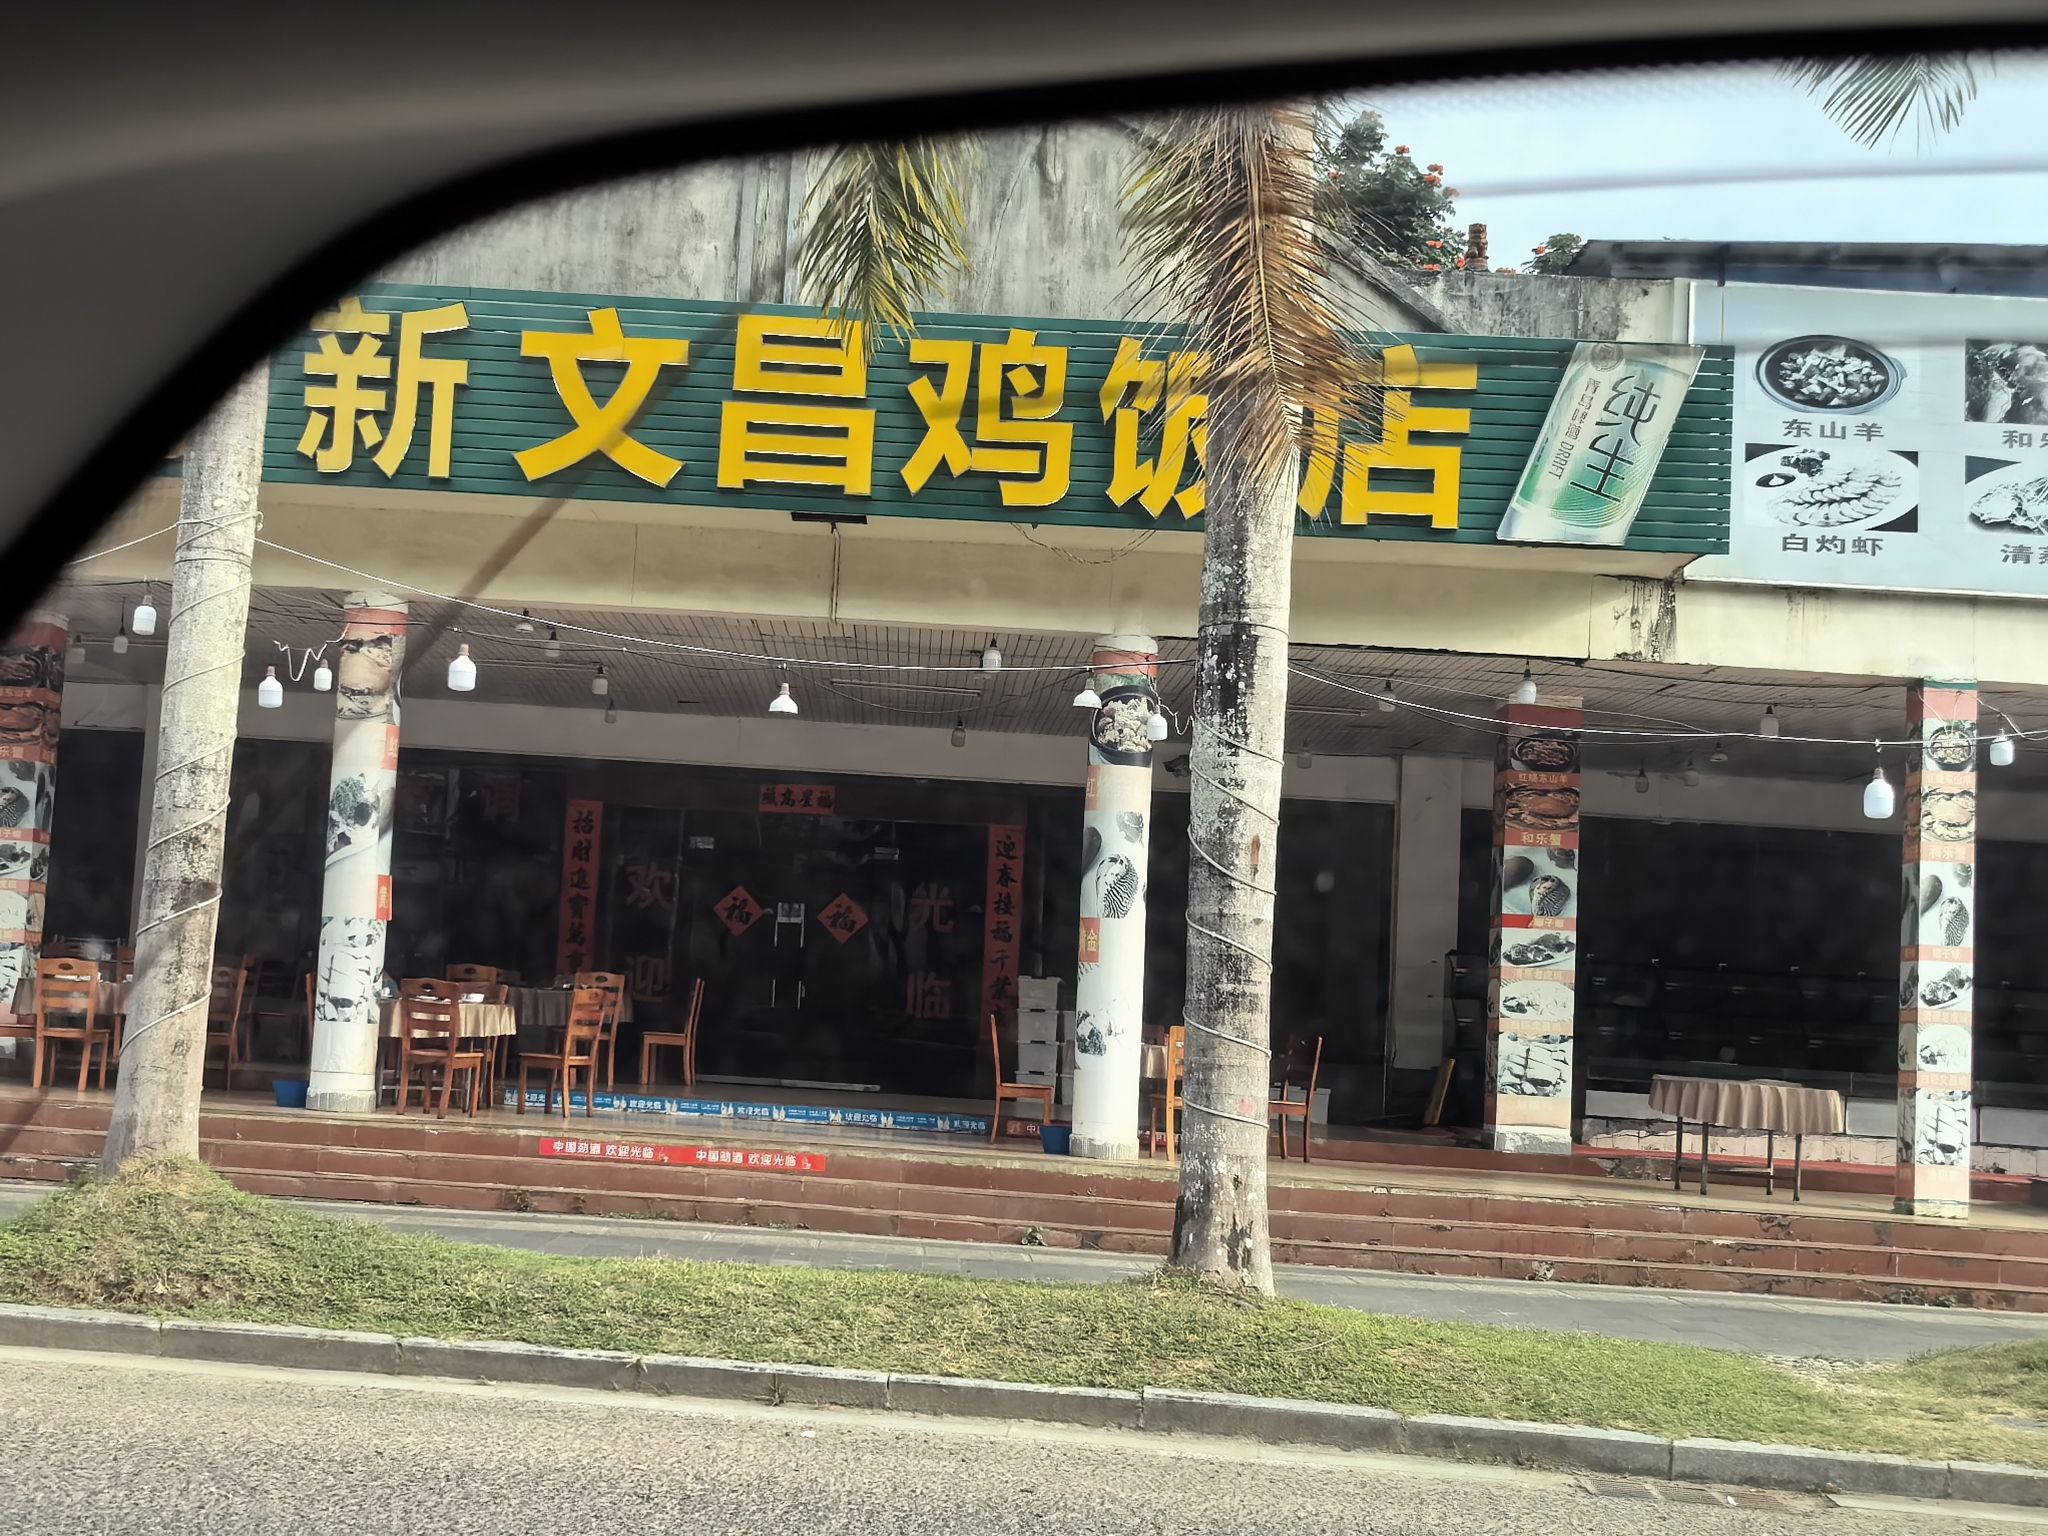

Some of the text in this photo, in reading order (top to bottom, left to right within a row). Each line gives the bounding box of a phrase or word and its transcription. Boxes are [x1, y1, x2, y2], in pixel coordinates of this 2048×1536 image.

[1782, 418, 1885, 442] 东山羊
[1548, 441, 1575, 480] DRAFT
[1782, 533, 1884, 557] 白灼虾
[906, 882, 954, 1018] 光临
[606, 1144, 654, 1158] 欢迎光临
[748, 1153, 796, 1167] 欢迎光临
